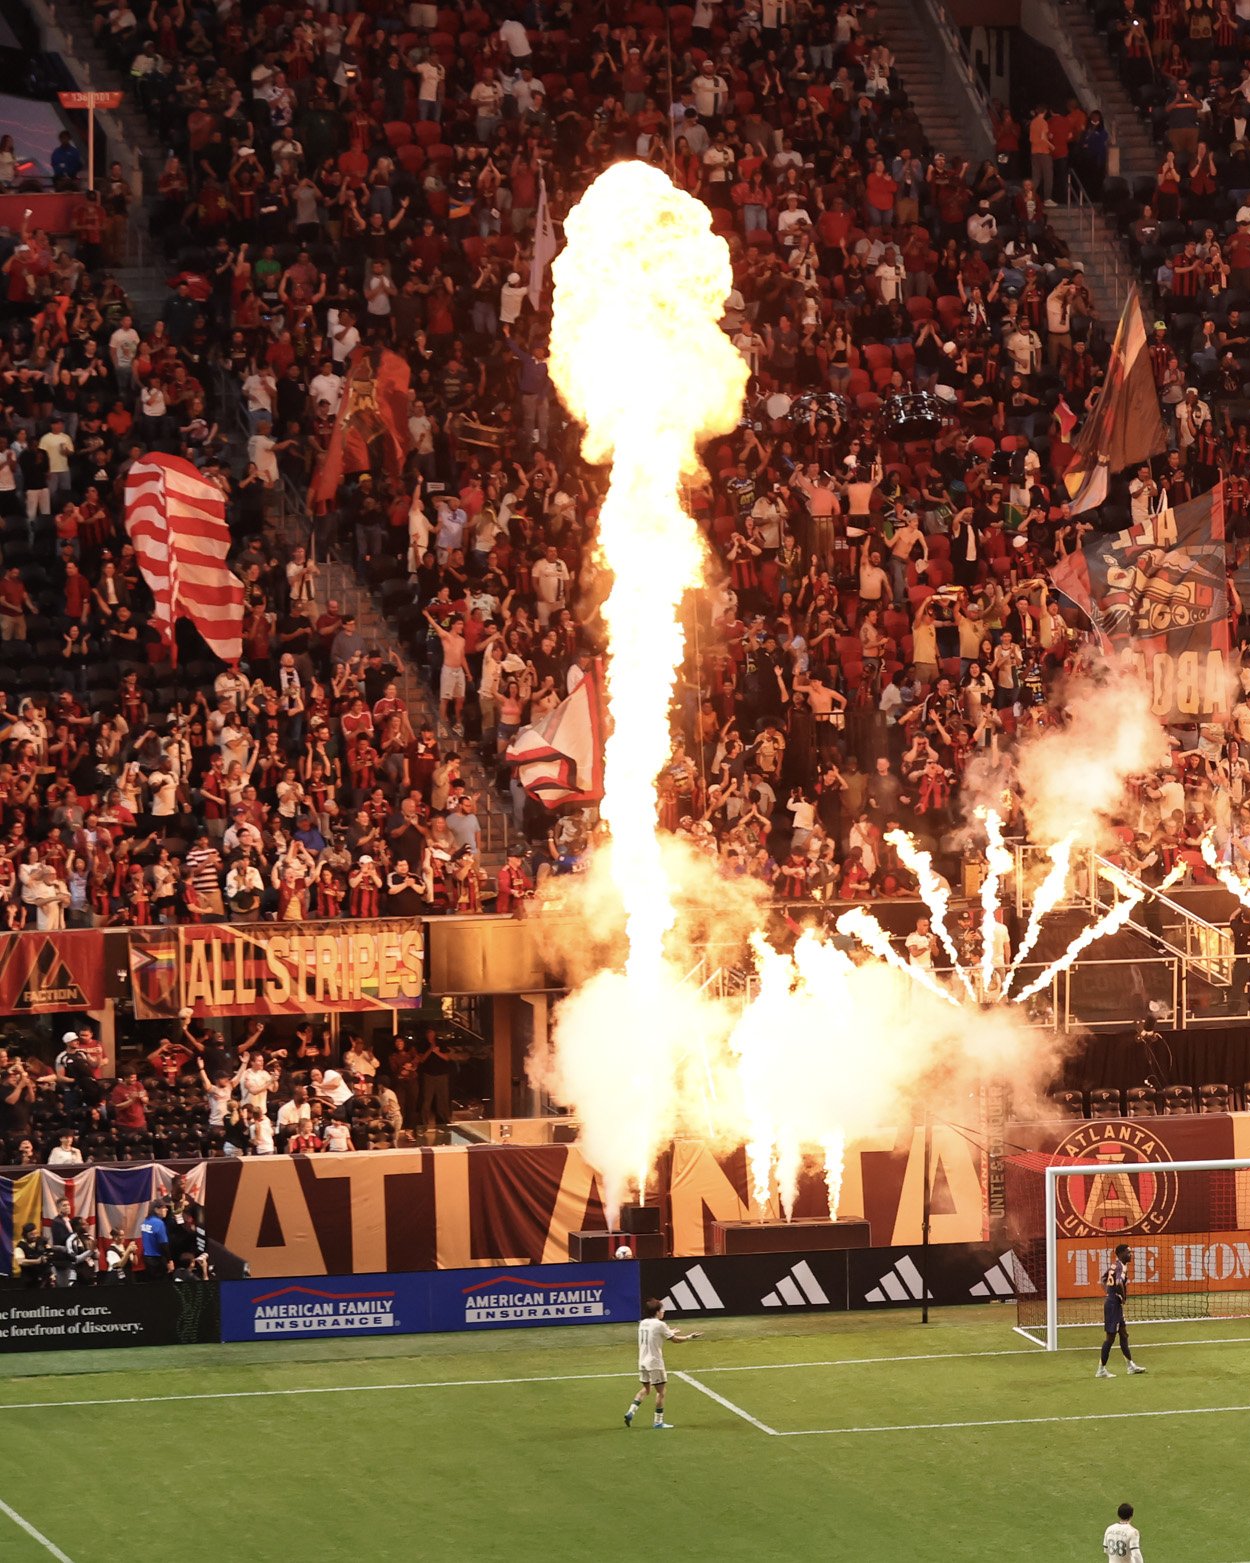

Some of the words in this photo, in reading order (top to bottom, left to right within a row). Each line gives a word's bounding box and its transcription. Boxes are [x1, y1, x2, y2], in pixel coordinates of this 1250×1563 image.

[187, 937, 256, 1007] ALL
[265, 930, 423, 1005] STRIPES
[23, 988, 78, 1003] FACTION
[1065, 1124, 1156, 1158] ATLANTA
[990, 1173, 1005, 1219] UNITE
[465, 1293, 544, 1308] AMERICAN
[549, 1289, 603, 1304] FAMILY
[10, 1305, 65, 1319] frontline
[66, 1304, 81, 1317] of
[81, 1306, 112, 1316] care.
[254, 1303, 334, 1319] AMERICAN
[338, 1300, 394, 1315] FAMILY
[476, 1305, 593, 1320] INSURANCE
[10, 1323, 66, 1337] forefront
[67, 1321, 82, 1335] of
[82, 1321, 144, 1335] discovery.
[265, 1316, 383, 1330] INSURANCE
